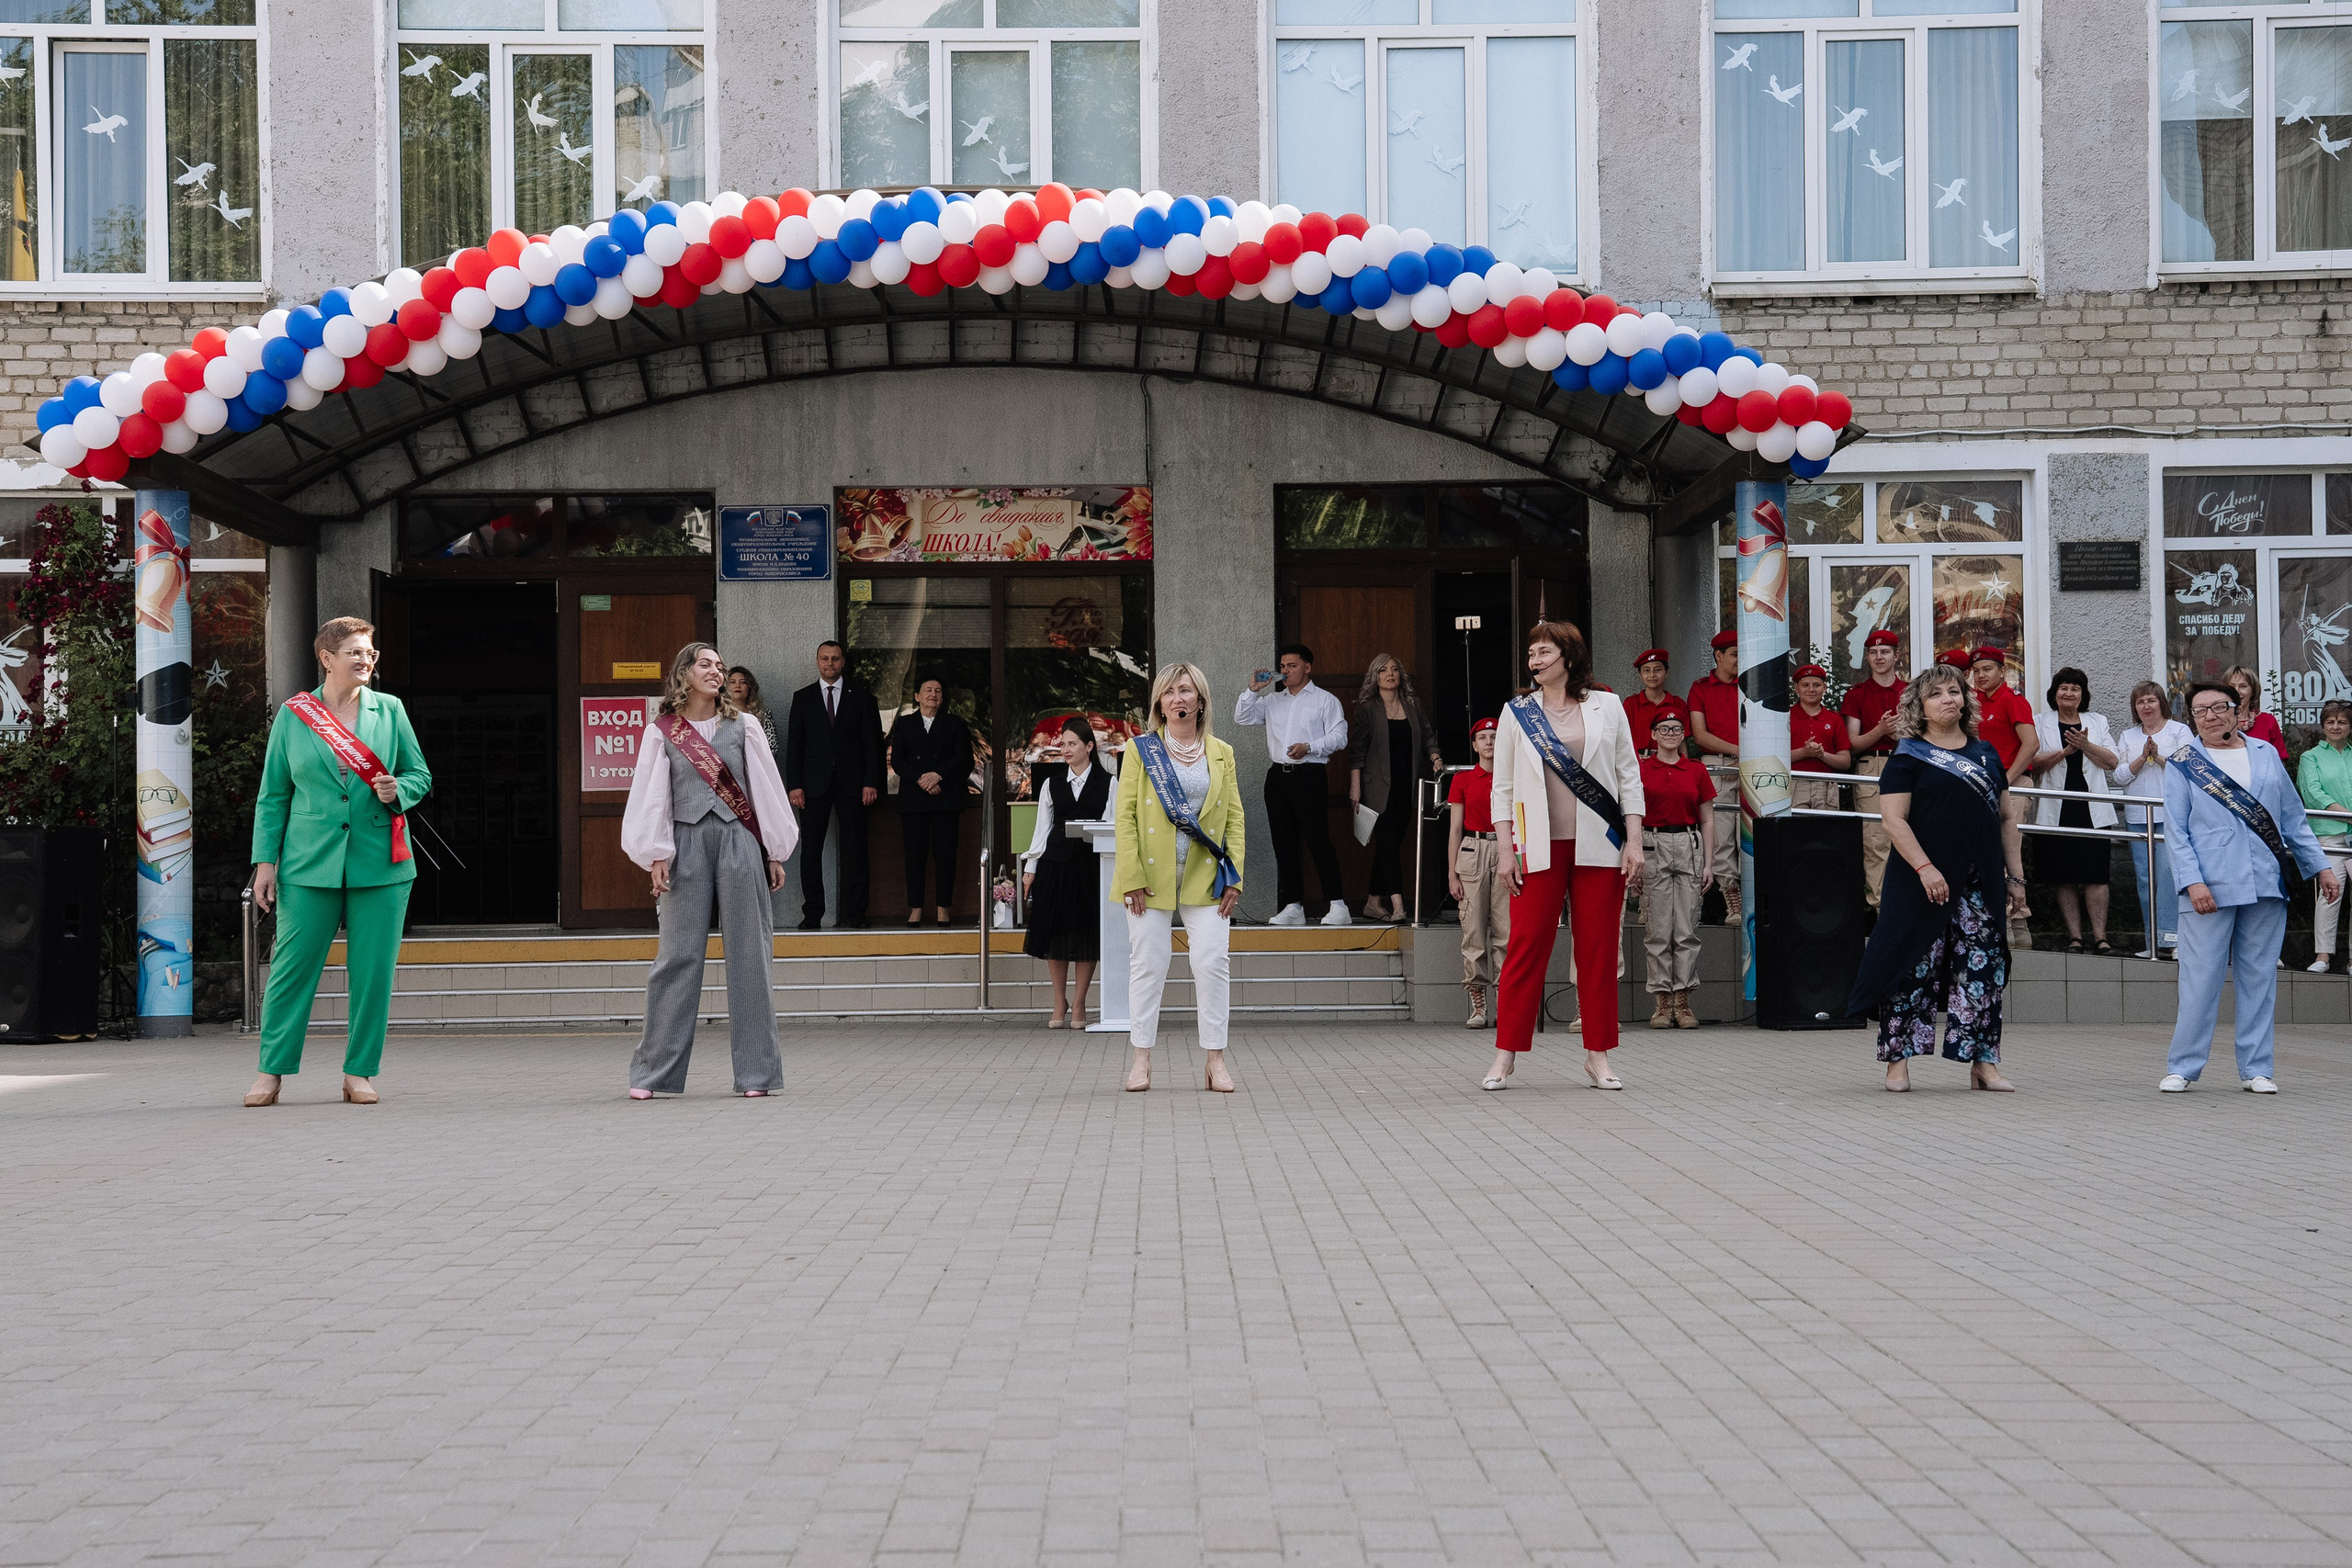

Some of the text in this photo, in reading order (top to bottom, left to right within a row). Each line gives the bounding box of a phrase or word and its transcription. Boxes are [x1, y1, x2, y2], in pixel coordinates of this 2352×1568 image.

[924, 500, 1065, 533] До свидания,
[2198, 490, 2256, 516] С Днем
[2209, 501, 2264, 533] Победы!
[740, 553, 778, 561] ШКОЛА
[784, 553, 794, 561] №
[922, 533, 1001, 553] ШКОЛА!
[2179, 614, 2245, 625] СПАСИБО ДЕДУ
[2185, 625, 2240, 636] ЗА ПОБЕДУ!
[2284, 671, 2322, 702] 80
[286, 694, 331, 726] Классный
[588, 710, 643, 728] ВХОД
[1527, 706, 1553, 746] Классный
[594, 735, 634, 755] №1
[689, 739, 722, 772] Классный
[1147, 736, 1169, 780] Классный
[590, 766, 594, 777] 1
[2189, 757, 2232, 795] Классный
[1568, 776, 1602, 805] 2025
[2203, 783, 2258, 826] руководитель
[2256, 822, 2282, 853] 2025
